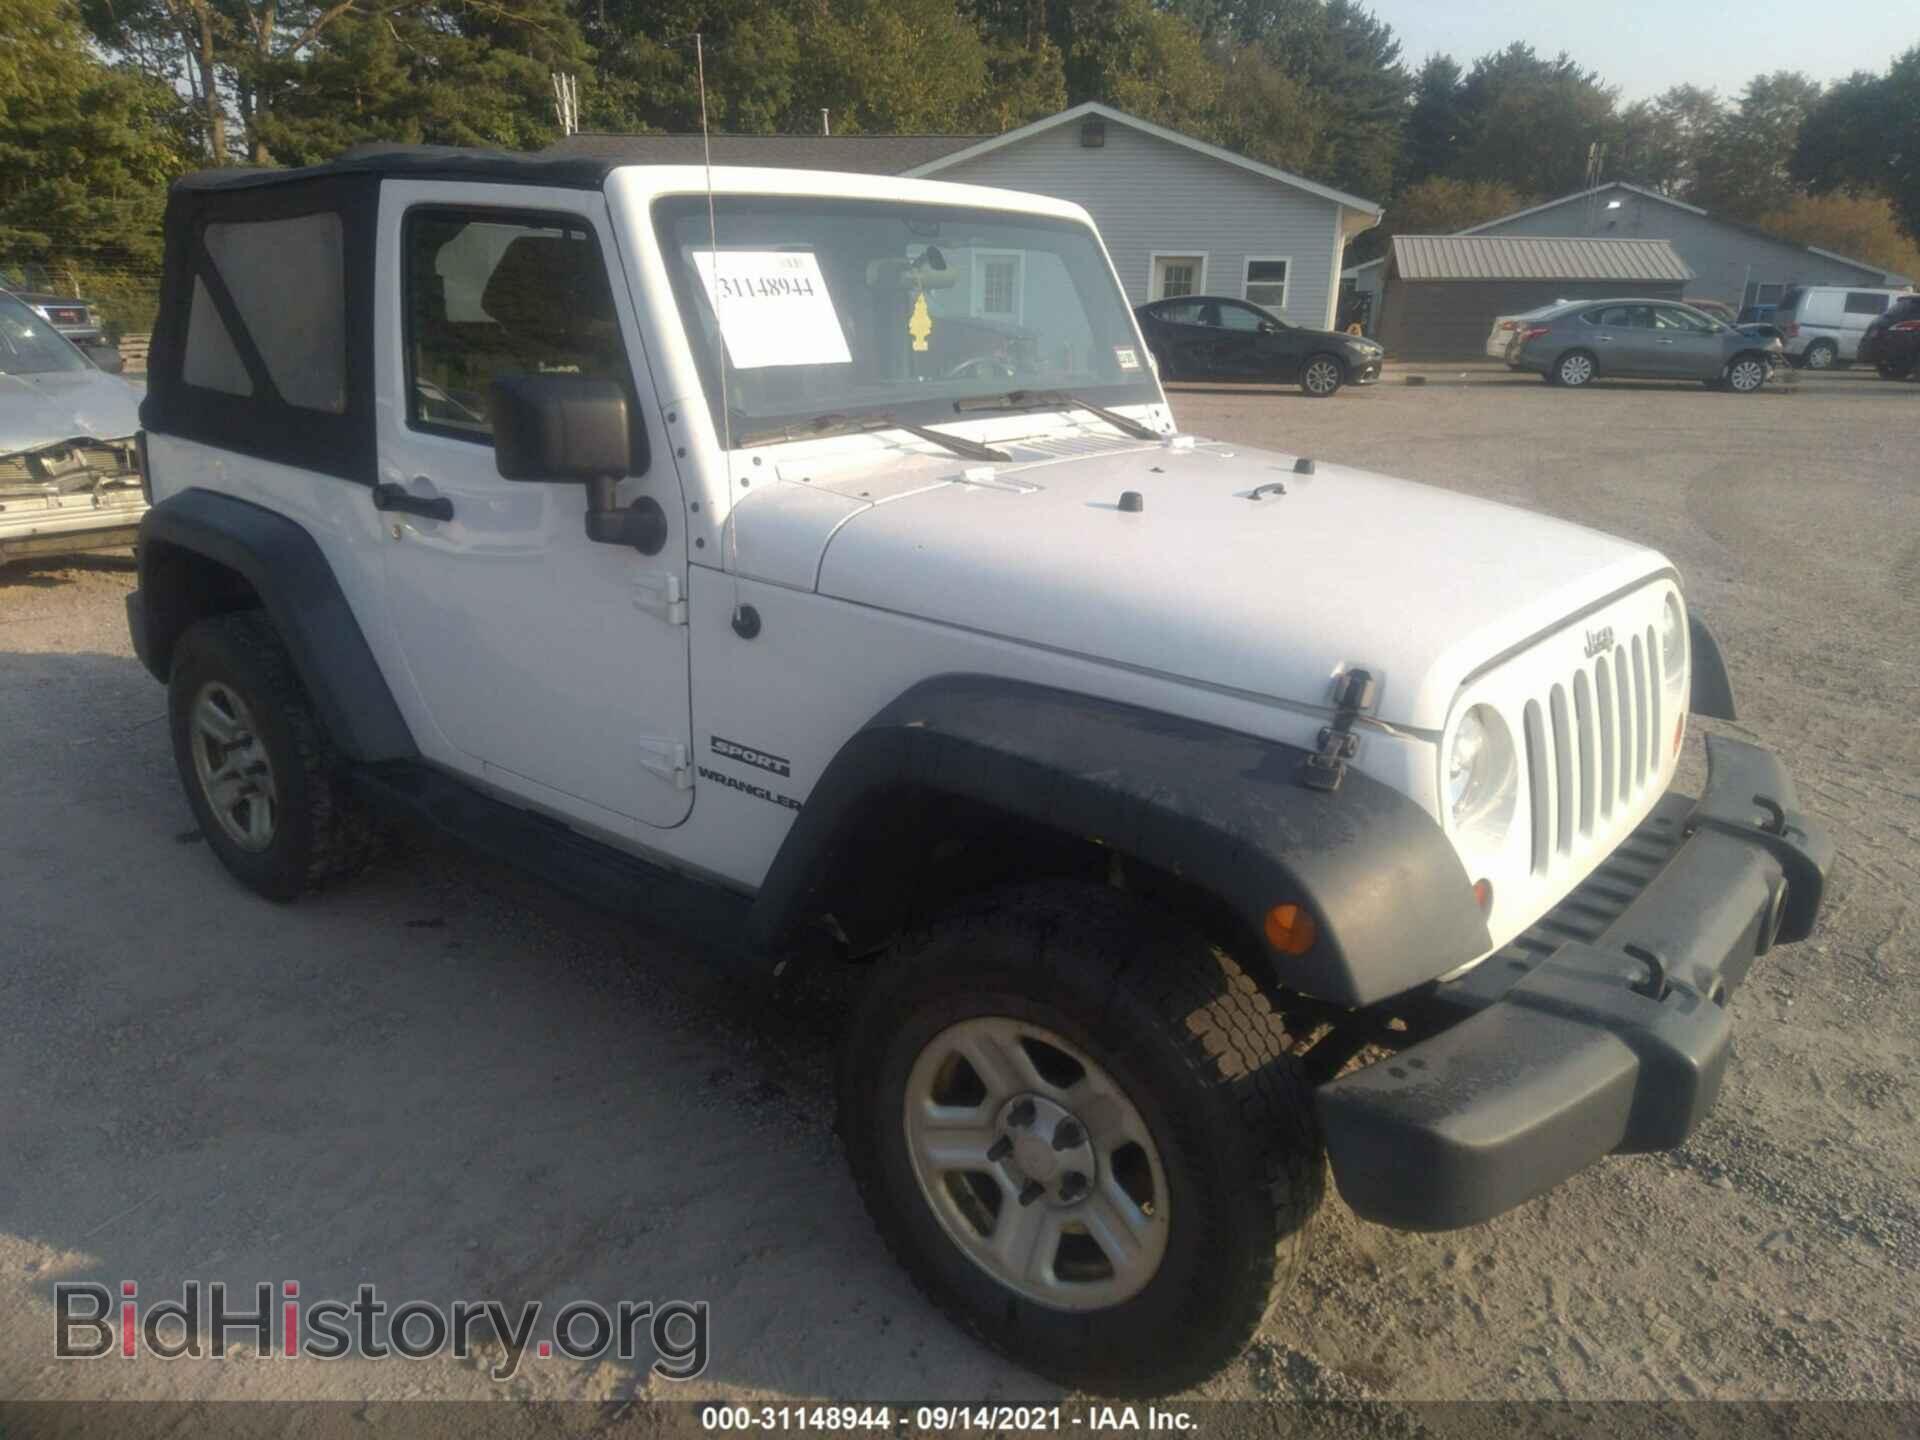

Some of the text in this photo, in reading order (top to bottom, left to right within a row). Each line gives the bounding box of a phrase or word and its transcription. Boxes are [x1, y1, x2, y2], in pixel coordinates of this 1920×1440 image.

[719, 277, 814, 298] 31148944
[1583, 627, 1614, 658] Jeep
[711, 738, 788, 775] SPORT
[698, 766, 802, 810] WRANGLER
